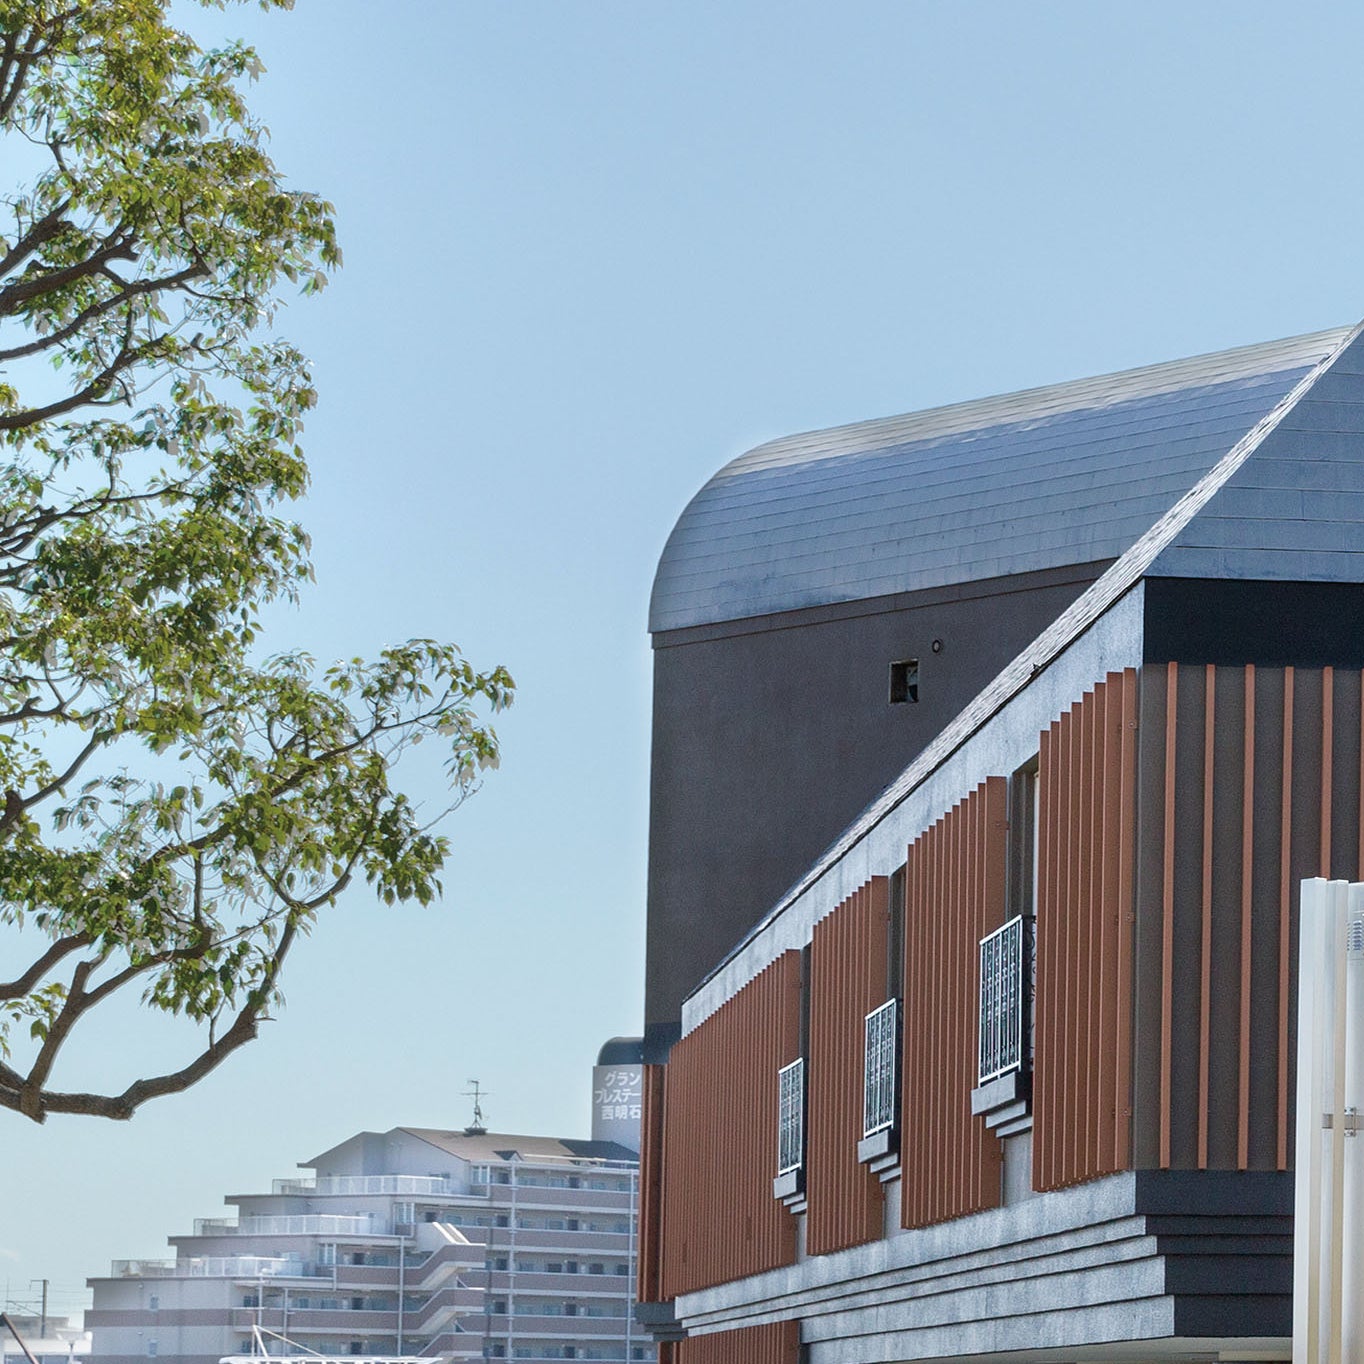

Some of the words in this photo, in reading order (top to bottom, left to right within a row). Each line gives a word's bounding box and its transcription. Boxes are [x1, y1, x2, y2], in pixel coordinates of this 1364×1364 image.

[604, 1070, 641, 1087] グラン
[601, 1104, 642, 1120] 西明石
